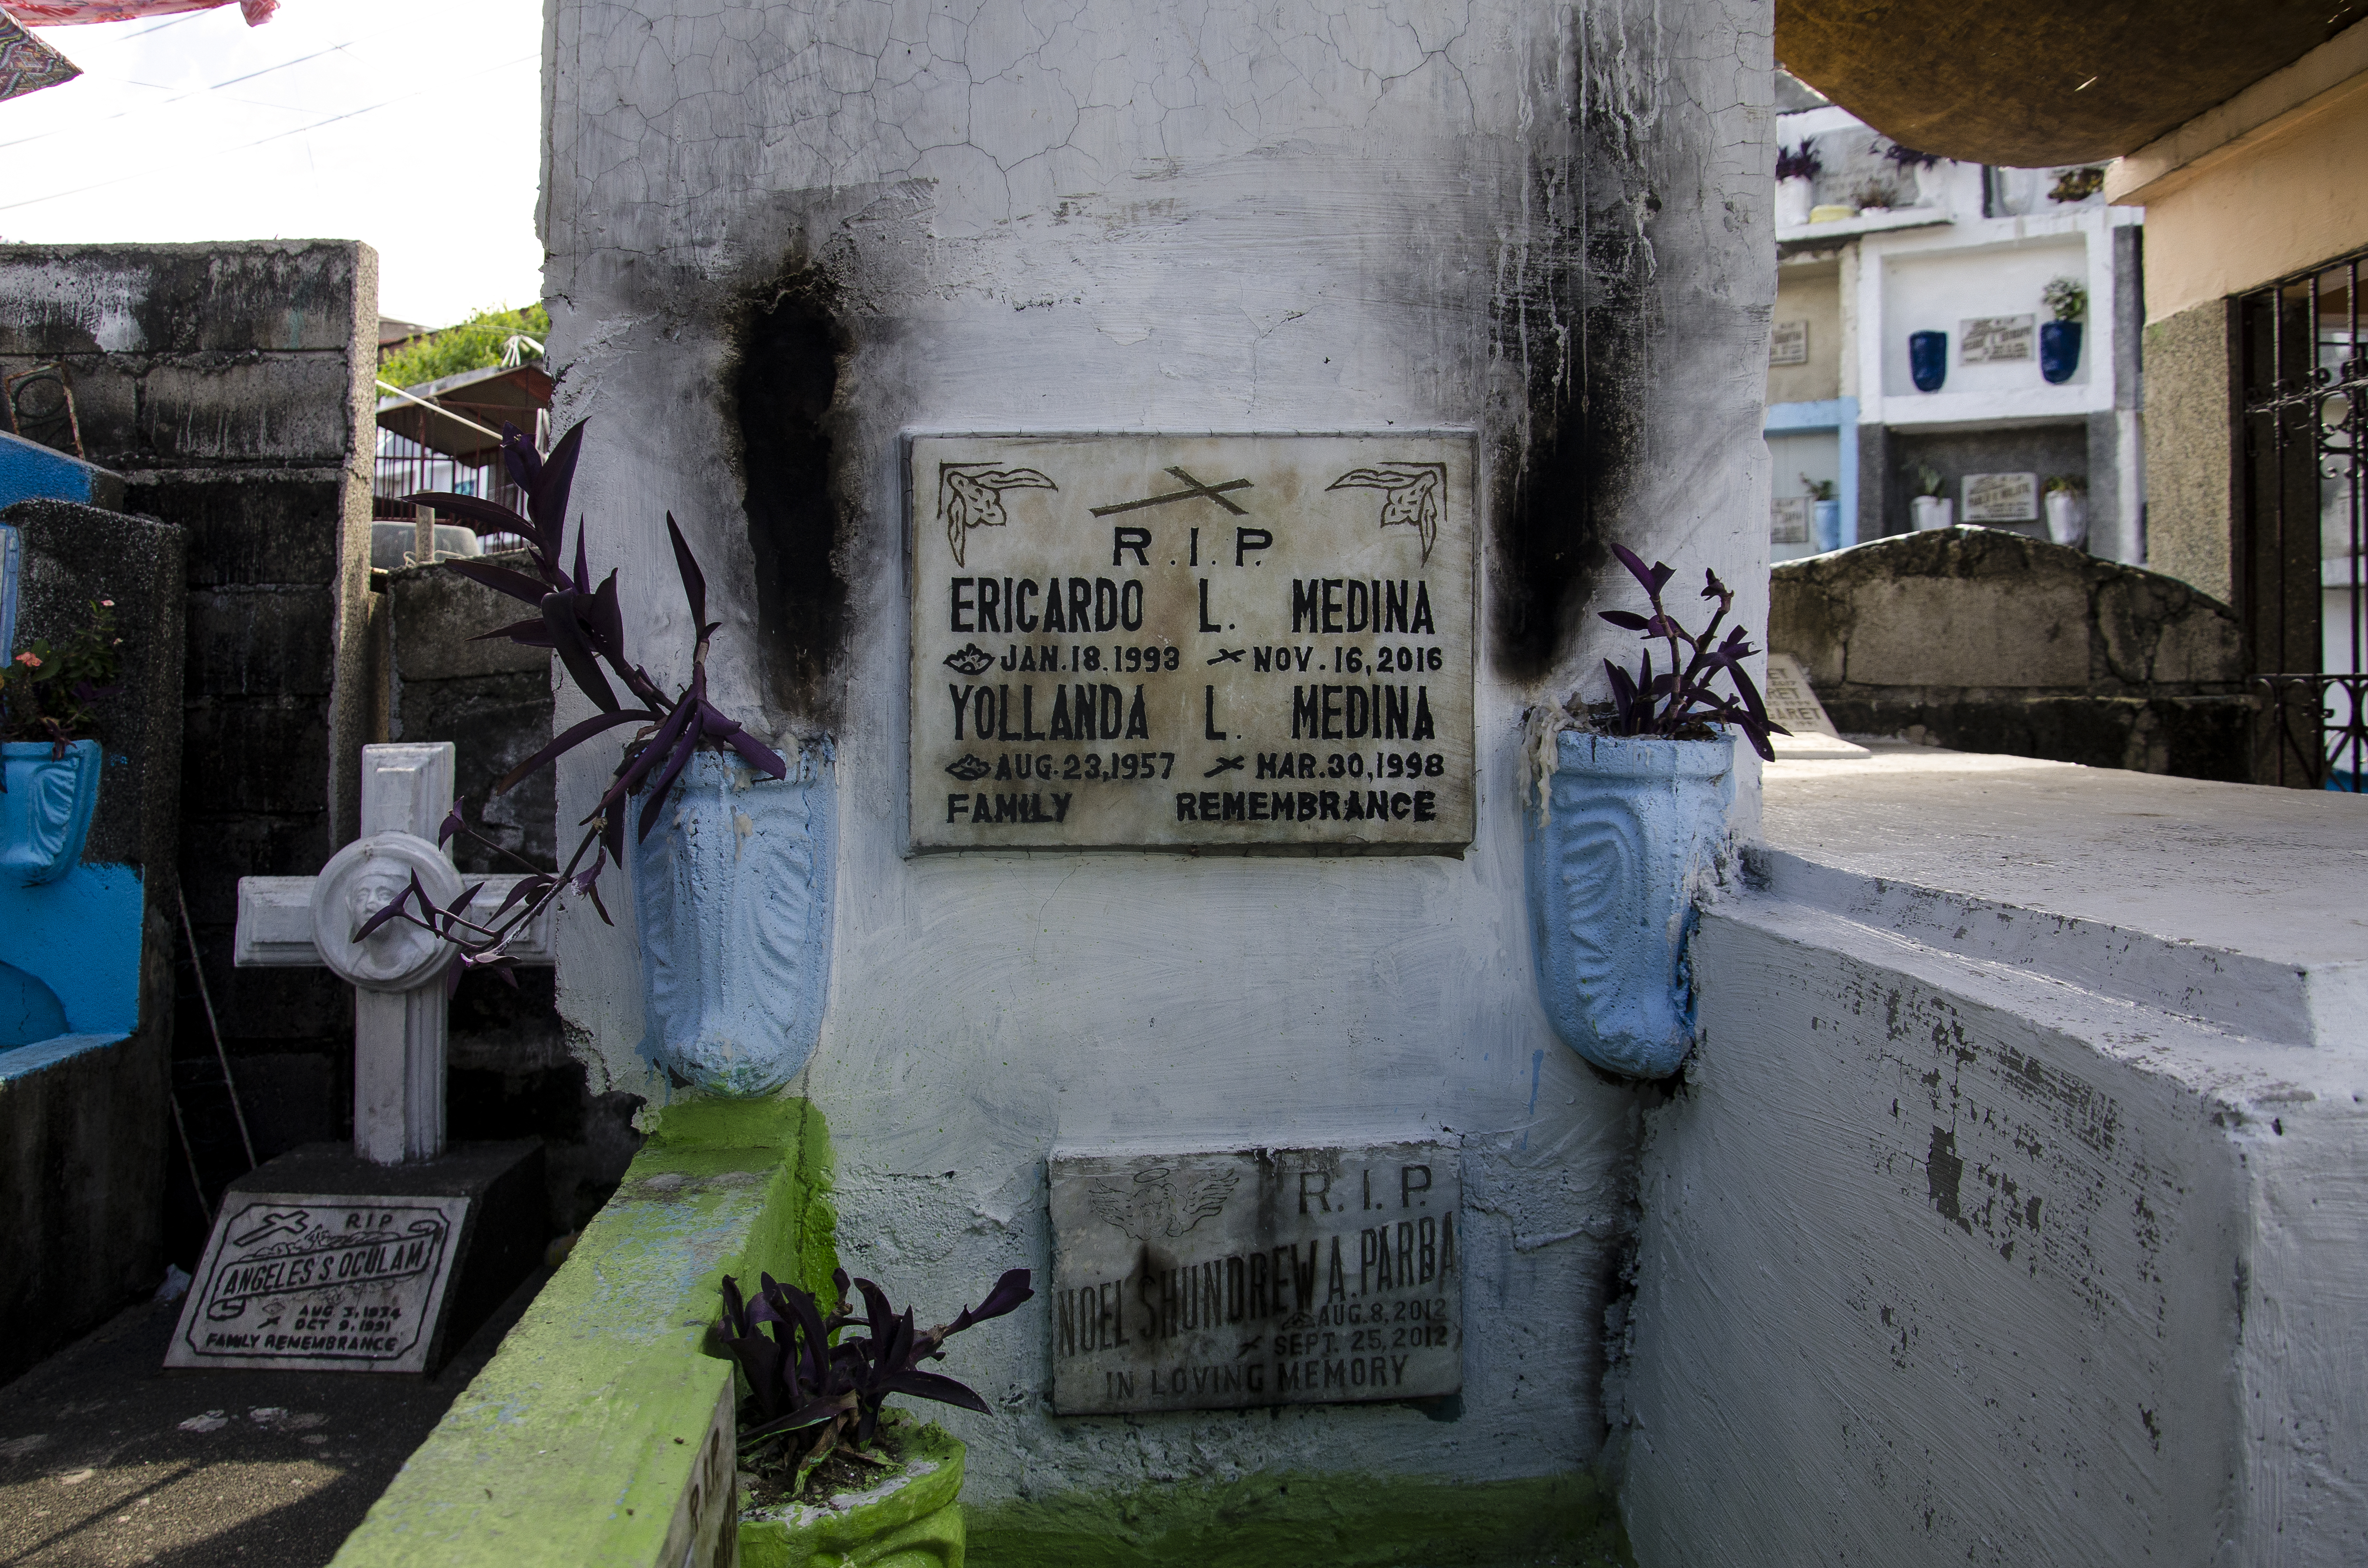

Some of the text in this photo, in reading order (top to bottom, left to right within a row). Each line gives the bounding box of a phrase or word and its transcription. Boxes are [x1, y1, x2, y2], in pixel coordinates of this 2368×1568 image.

[950, 576, 1436, 634] ERICARDO L. MEDINA
[949, 683, 1436, 741] YOLLANDA L. MEDINA
[946, 790, 1437, 823] FAMILY REMEMBRANCE
[223, 1257, 315, 1296] ANGELES
[338, 1240, 425, 1277] OCULAM
[298, 1304, 334, 1318] AUG
[1057, 1279, 1130, 1359] NOEL
[1138, 1240, 1319, 1340] SHUNDREW
[206, 1332, 398, 1352] FAMILY REMEMBRANCE
[294, 1318, 331, 1331] OCT
[1106, 1354, 1409, 1400] IN LOVING MEMORY
